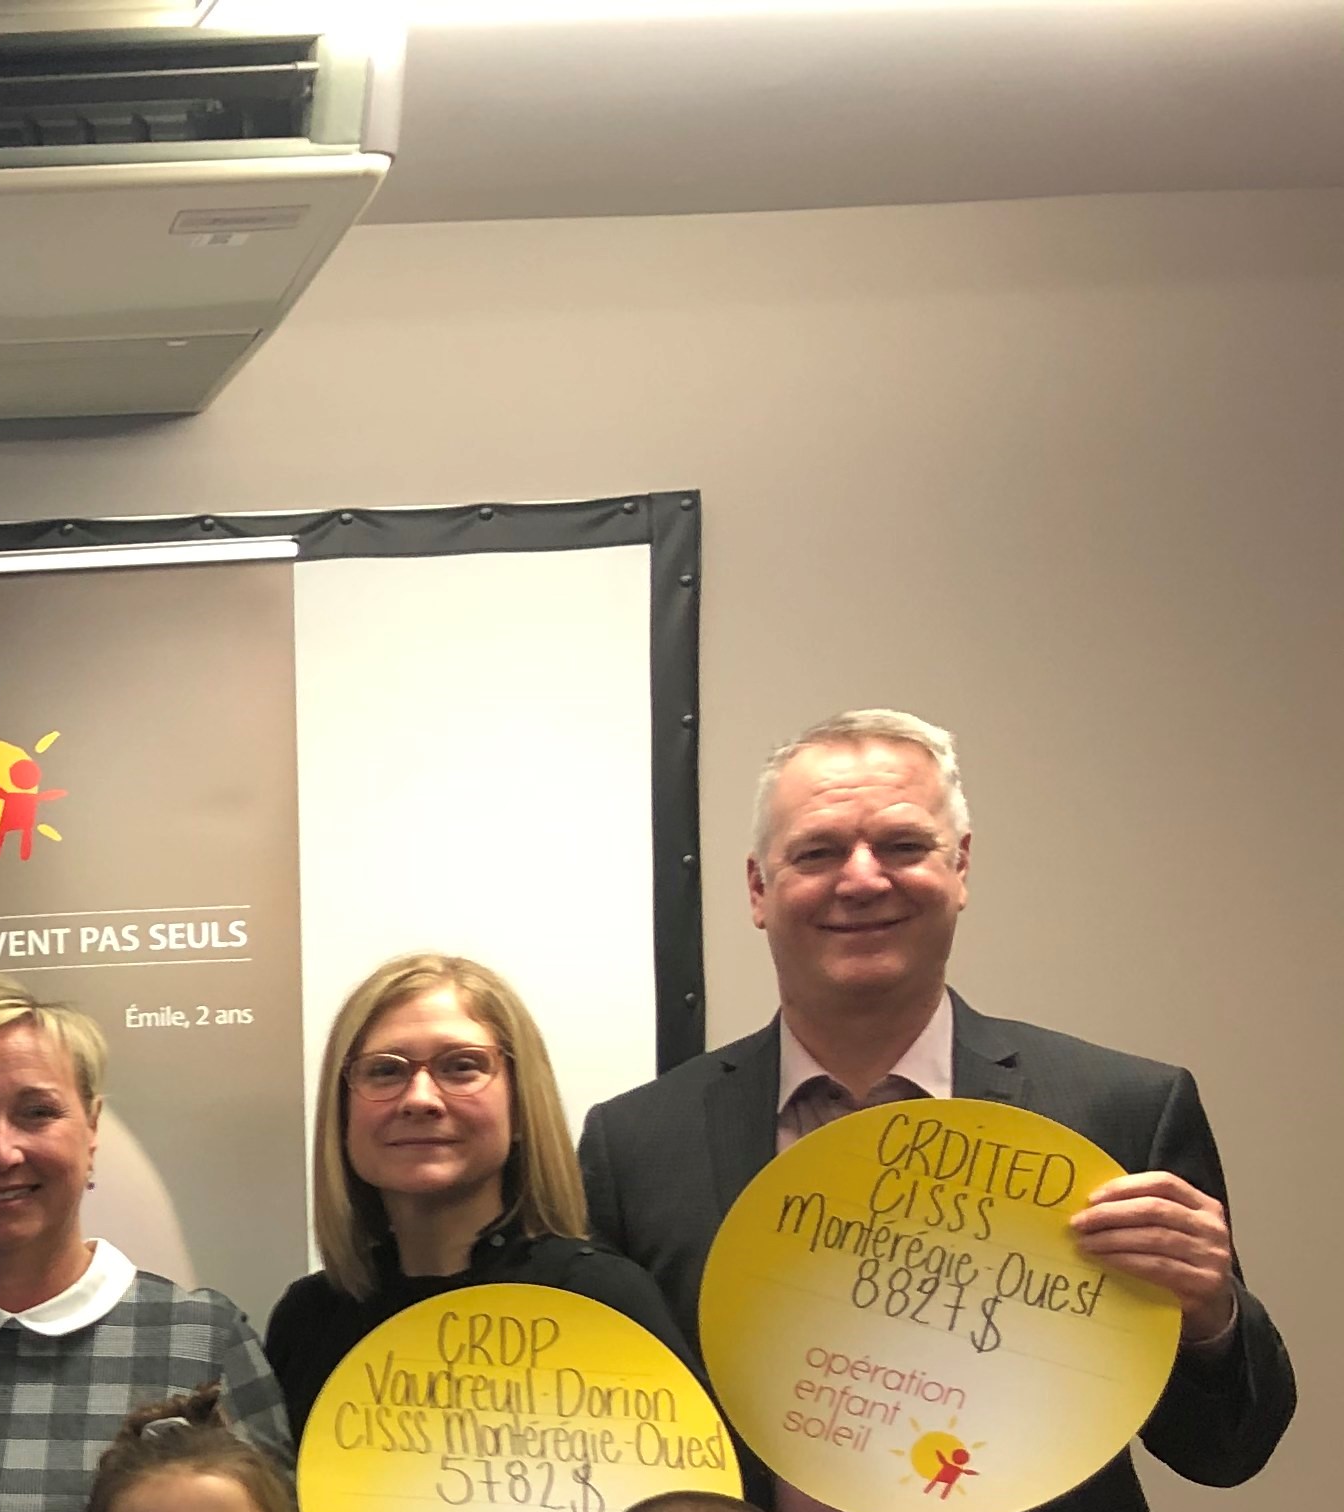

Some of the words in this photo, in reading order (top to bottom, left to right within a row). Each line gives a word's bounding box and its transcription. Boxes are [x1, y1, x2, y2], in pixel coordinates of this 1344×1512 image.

[80, 924, 140, 953] PAS
[149, 920, 248, 951] SEULS
[125, 1003, 190, 1029] Émile,
[195, 1005, 210, 1026] 2
[215, 1007, 254, 1025] ans
[437, 1311, 561, 1368] CRDP
[805, 1344, 967, 1410] opération
[794, 1376, 903, 1427] enfant
[782, 1408, 872, 1454] soleil
